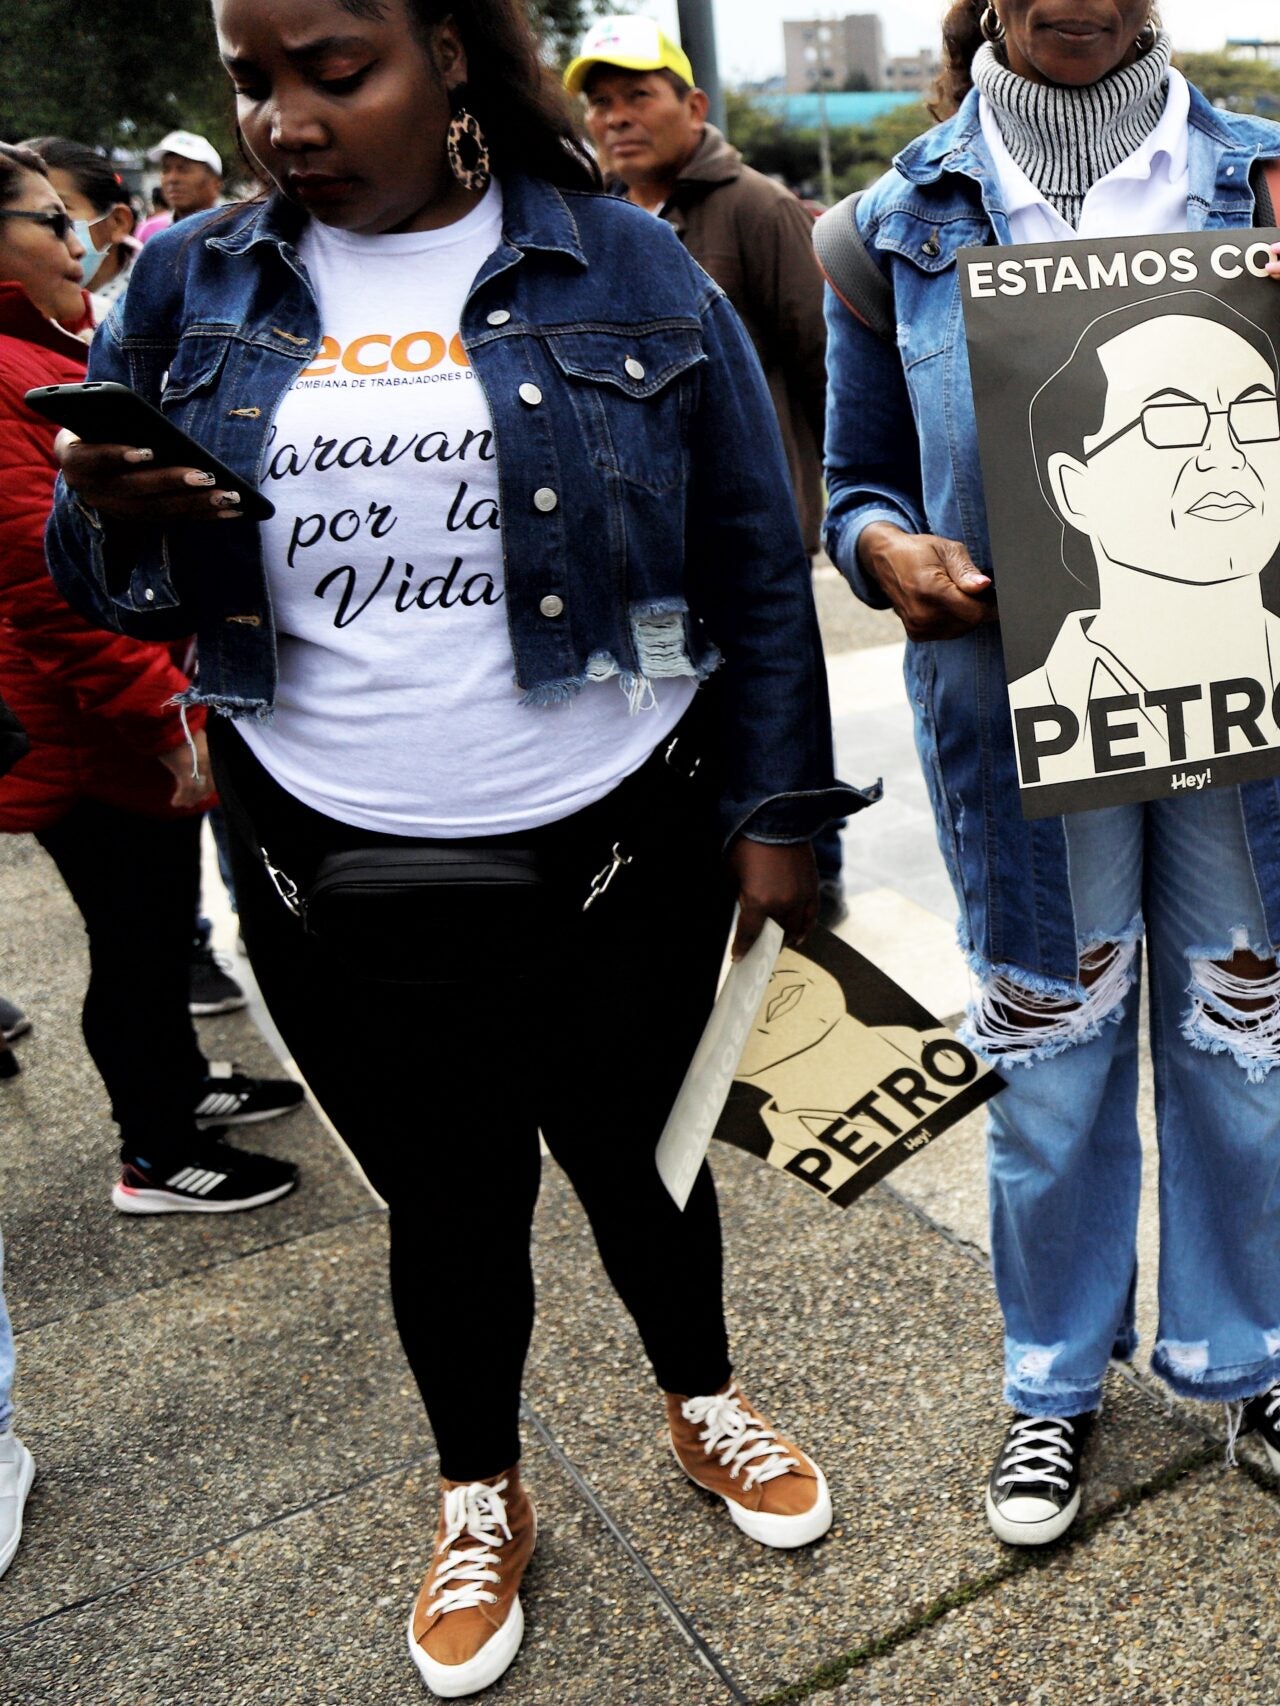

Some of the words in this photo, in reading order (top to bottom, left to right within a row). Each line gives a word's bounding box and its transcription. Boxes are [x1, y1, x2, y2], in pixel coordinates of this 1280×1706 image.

[967, 247, 1198, 298] ESTAMOS
[1210, 242, 1278, 279] CO
[351, 379, 367, 388] DE
[371, 371, 462, 387] TRABAJADORES
[260, 425, 497, 485] aravan
[287, 501, 398, 568] por
[446, 481, 501, 532] la
[314, 555, 505, 629] Vida
[1170, 767, 1212, 790] Hey!
[783, 1037, 979, 1195] PETRO
